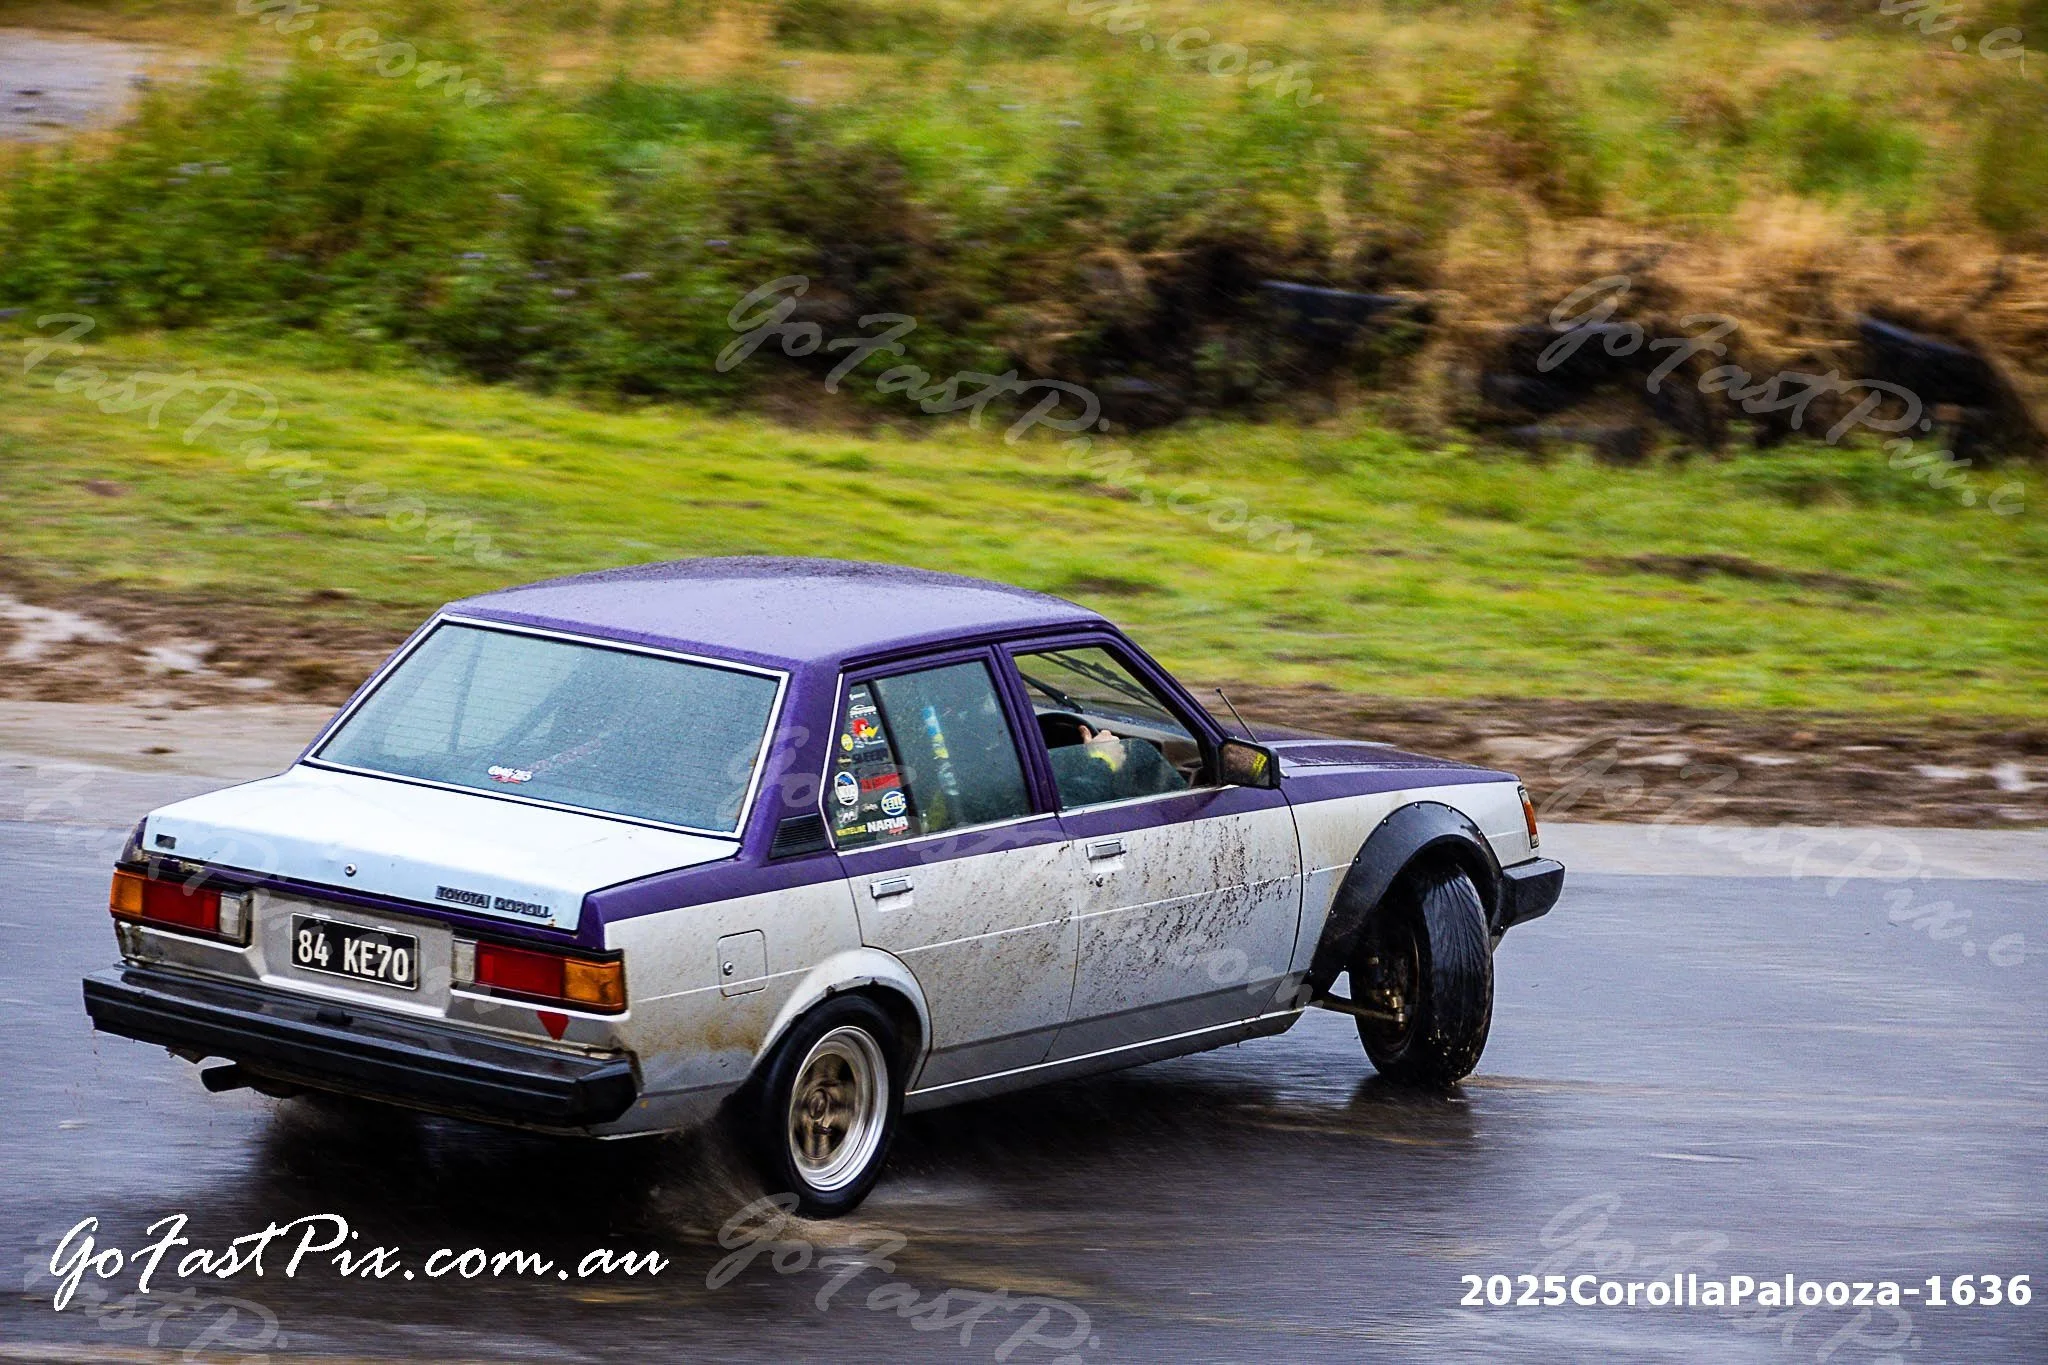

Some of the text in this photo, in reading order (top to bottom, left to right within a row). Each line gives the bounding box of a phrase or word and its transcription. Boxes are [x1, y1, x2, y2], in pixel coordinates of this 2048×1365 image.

[867, 816, 908, 833] NARVA
[435, 886, 487, 907] TOYOTA
[298, 929, 410, 982] 84 KE70
